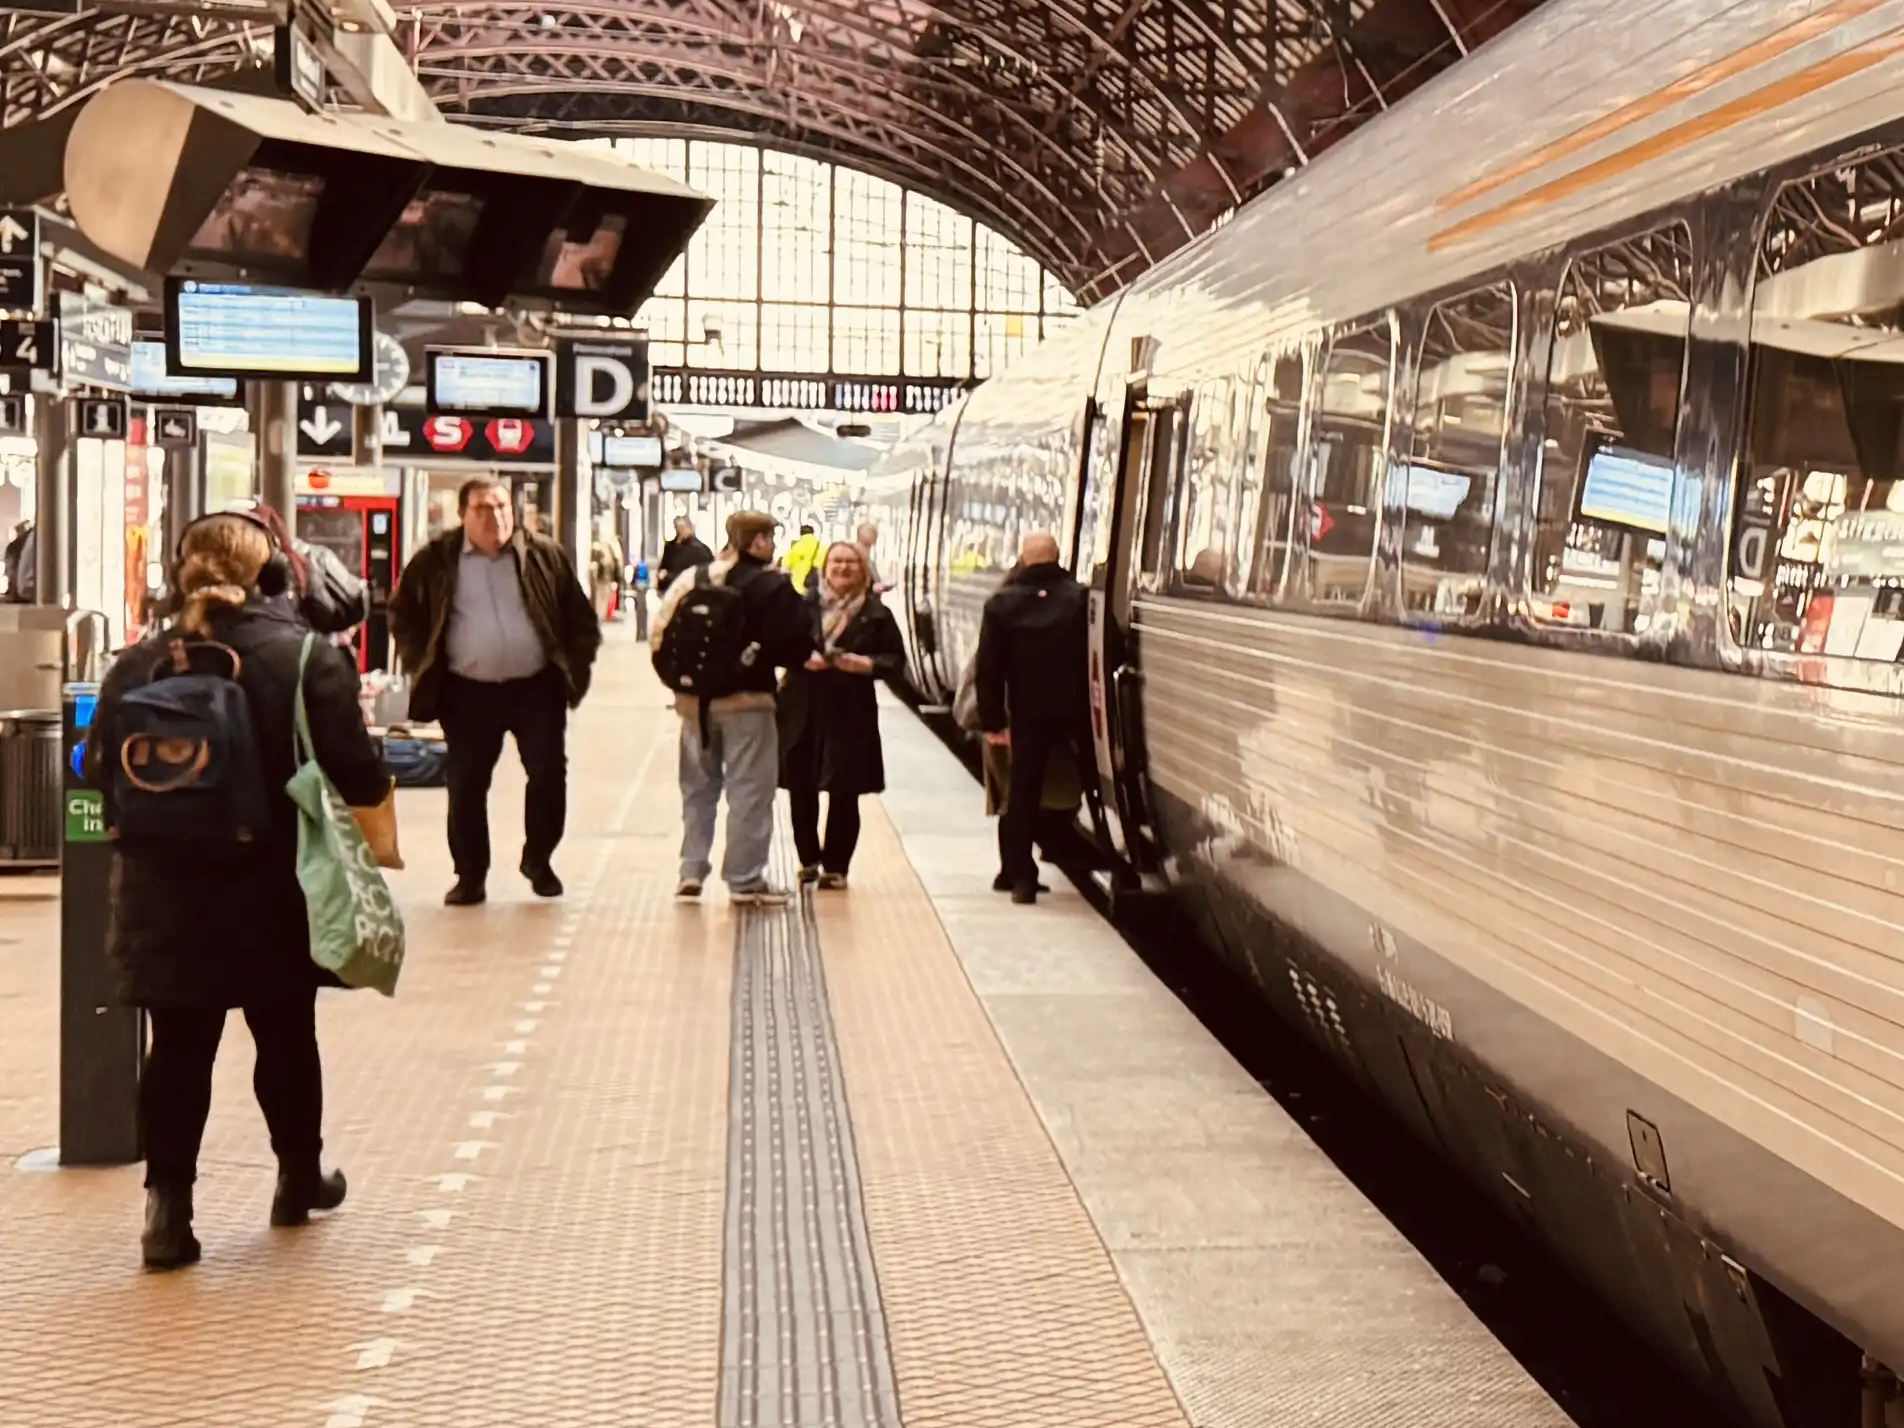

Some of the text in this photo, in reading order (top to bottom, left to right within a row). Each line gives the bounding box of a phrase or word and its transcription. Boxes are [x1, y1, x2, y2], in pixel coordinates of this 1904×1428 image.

[16, 336, 38, 364] 4
[575, 356, 634, 416] D
[432, 416, 462, 445] S
[69, 799, 102, 815] Che
